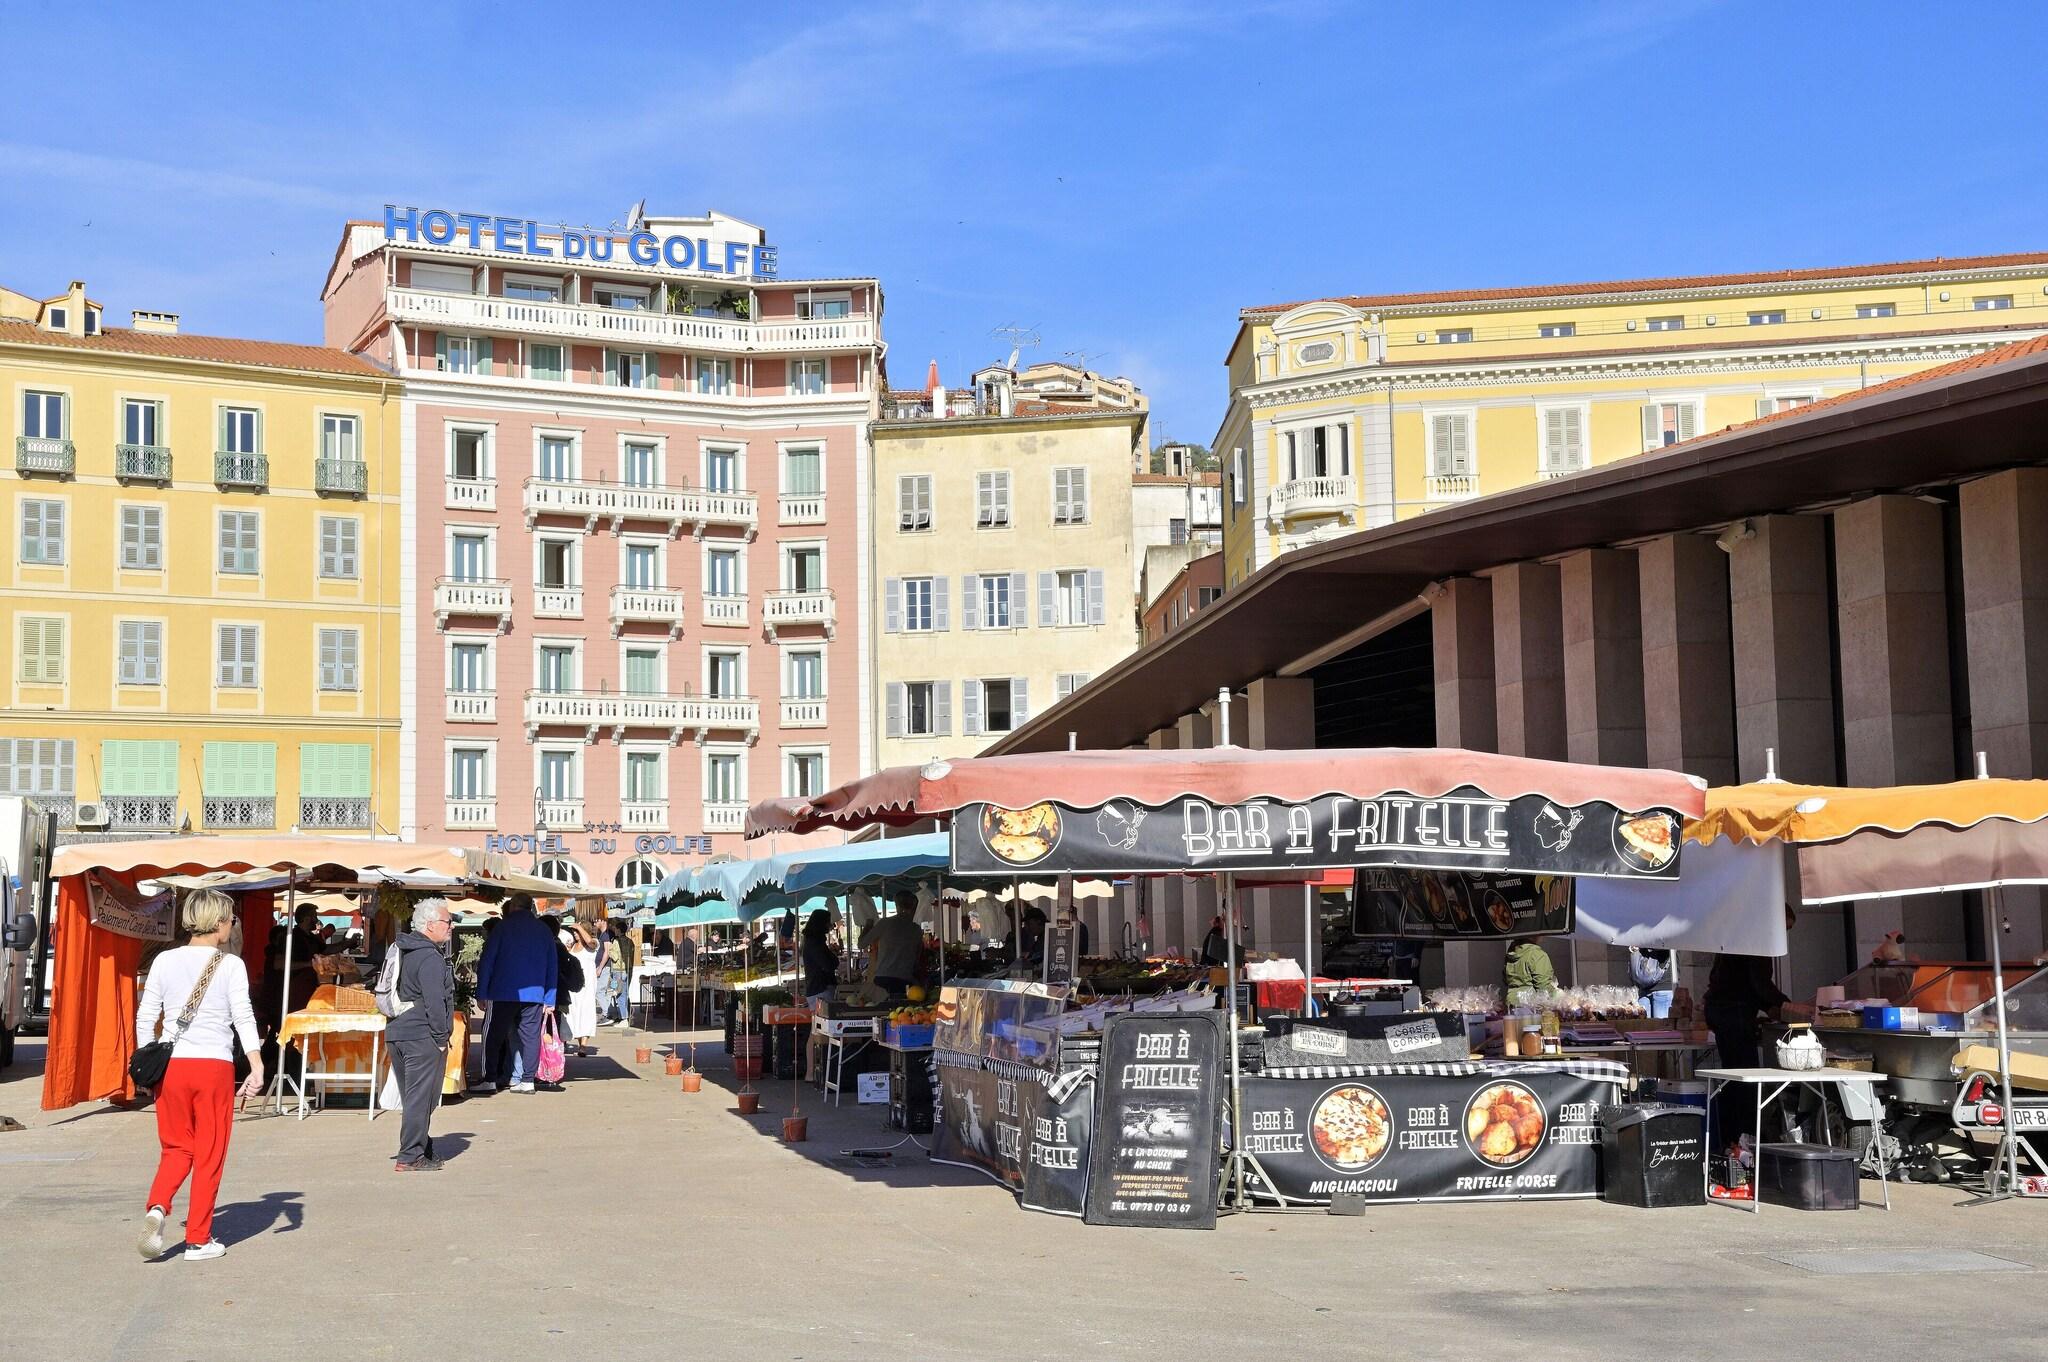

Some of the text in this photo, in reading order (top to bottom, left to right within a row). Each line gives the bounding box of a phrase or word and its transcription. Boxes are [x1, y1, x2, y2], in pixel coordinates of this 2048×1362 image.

[383, 204, 778, 280] HOTEL DU GOLFE
[1182, 799, 1272, 856] BAR
[1329, 796, 1510, 855] FRITELLE
[486, 834, 712, 855] HOTEL DU GOLFE
[1393, 1032, 1436, 1047] CORSICA
[1395, 1024, 1429, 1037] CORSE
[1136, 1033, 1173, 1059] BAR
[1122, 1064, 1200, 1089] FRITELLE
[1252, 1107, 1295, 1131] BAR À
[1408, 1104, 1449, 1127] BAR À
[1559, 1103, 1586, 1122] BAR
[1244, 1133, 1304, 1153] FRITELLE
[1399, 1129, 1458, 1150] FRITELLE
[1549, 1126, 1604, 1145] FRITELL
[1135, 1148, 1145, 1157] LA
[1649, 1145, 1700, 1168] Bonheur
[1134, 1160, 1172, 1170] AU CHOIX
[1309, 1178, 1398, 1194] MIGLIACCIOLI
[1456, 1174, 1557, 1190] FRITELLE CORSE
[1111, 1200, 1127, 1210] TÉL.
[1130, 1202, 1141, 1210] 07
[1154, 1204, 1165, 1212] 07
[1167, 1204, 1177, 1212] 03
[1179, 1205, 1191, 1213] 67
